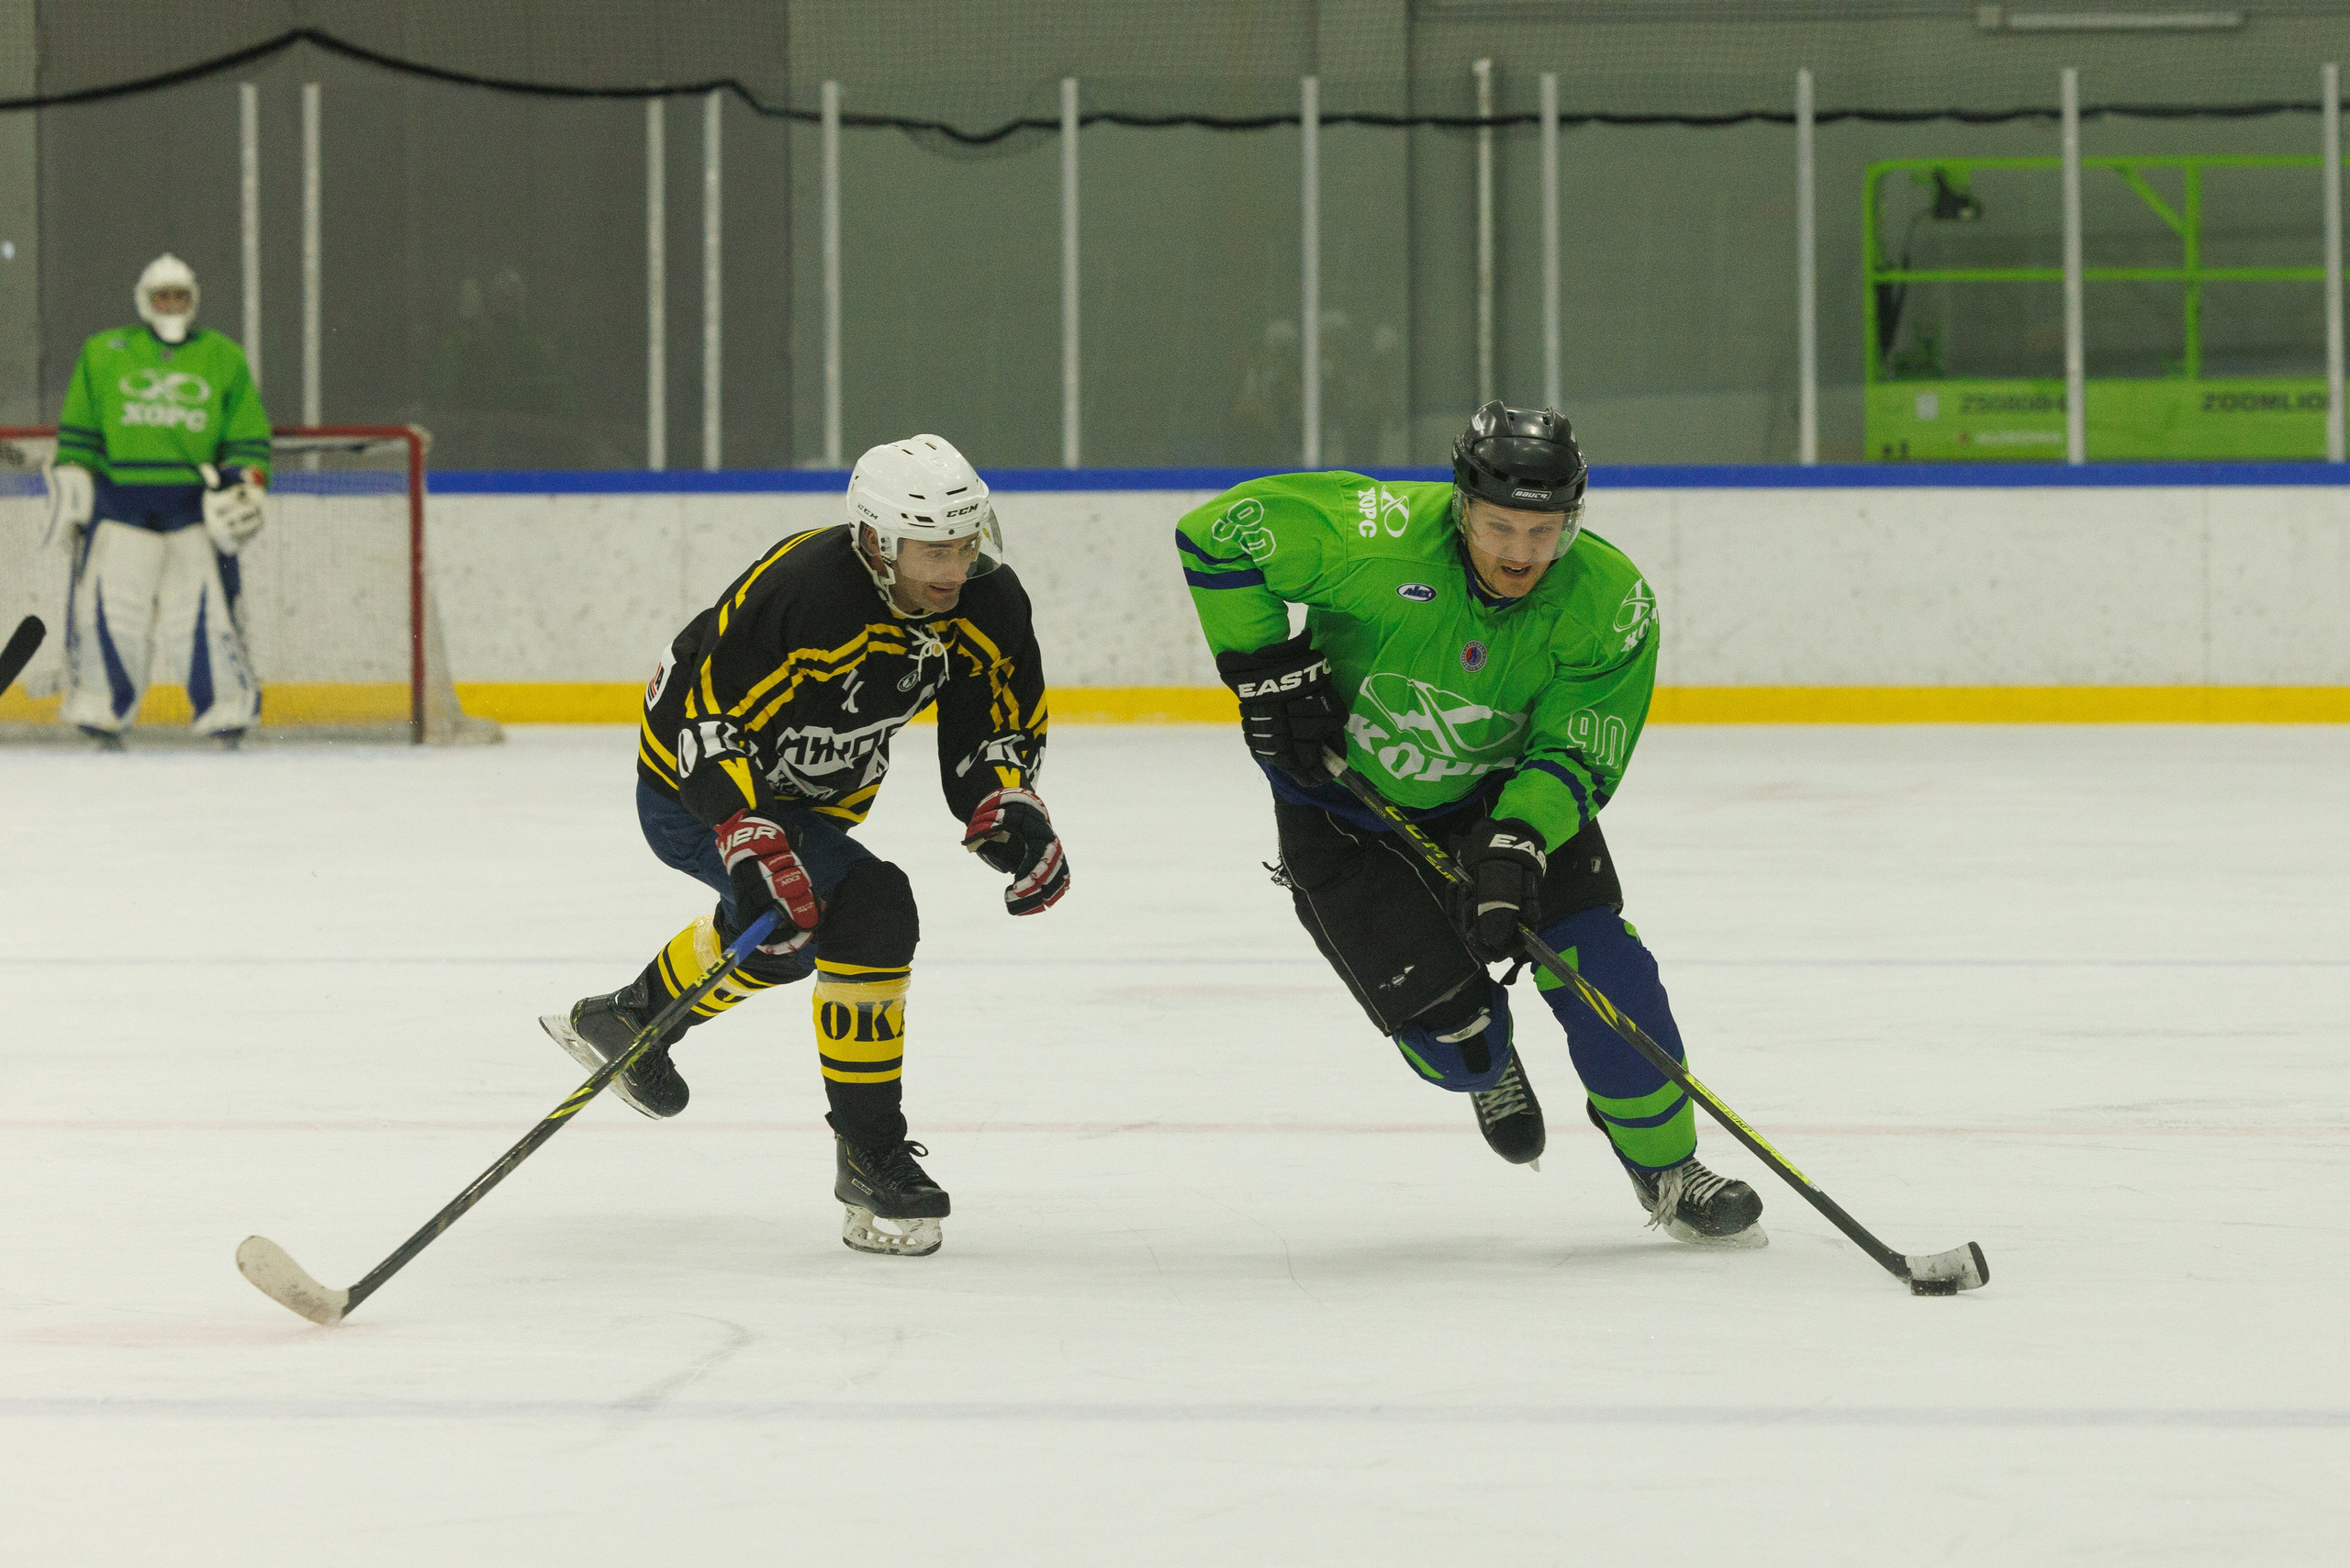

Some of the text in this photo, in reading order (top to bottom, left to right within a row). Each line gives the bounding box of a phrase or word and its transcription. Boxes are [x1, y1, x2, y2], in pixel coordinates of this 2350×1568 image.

[2203, 392, 2332, 413] ZOOMLIO
[856, 503, 878, 521] CCM
[946, 503, 979, 519] CCM
[1567, 708, 1628, 769] 90
[719, 826, 778, 858] UER
[1384, 806, 1449, 859] CCM
[1424, 855, 1459, 883] SUP
